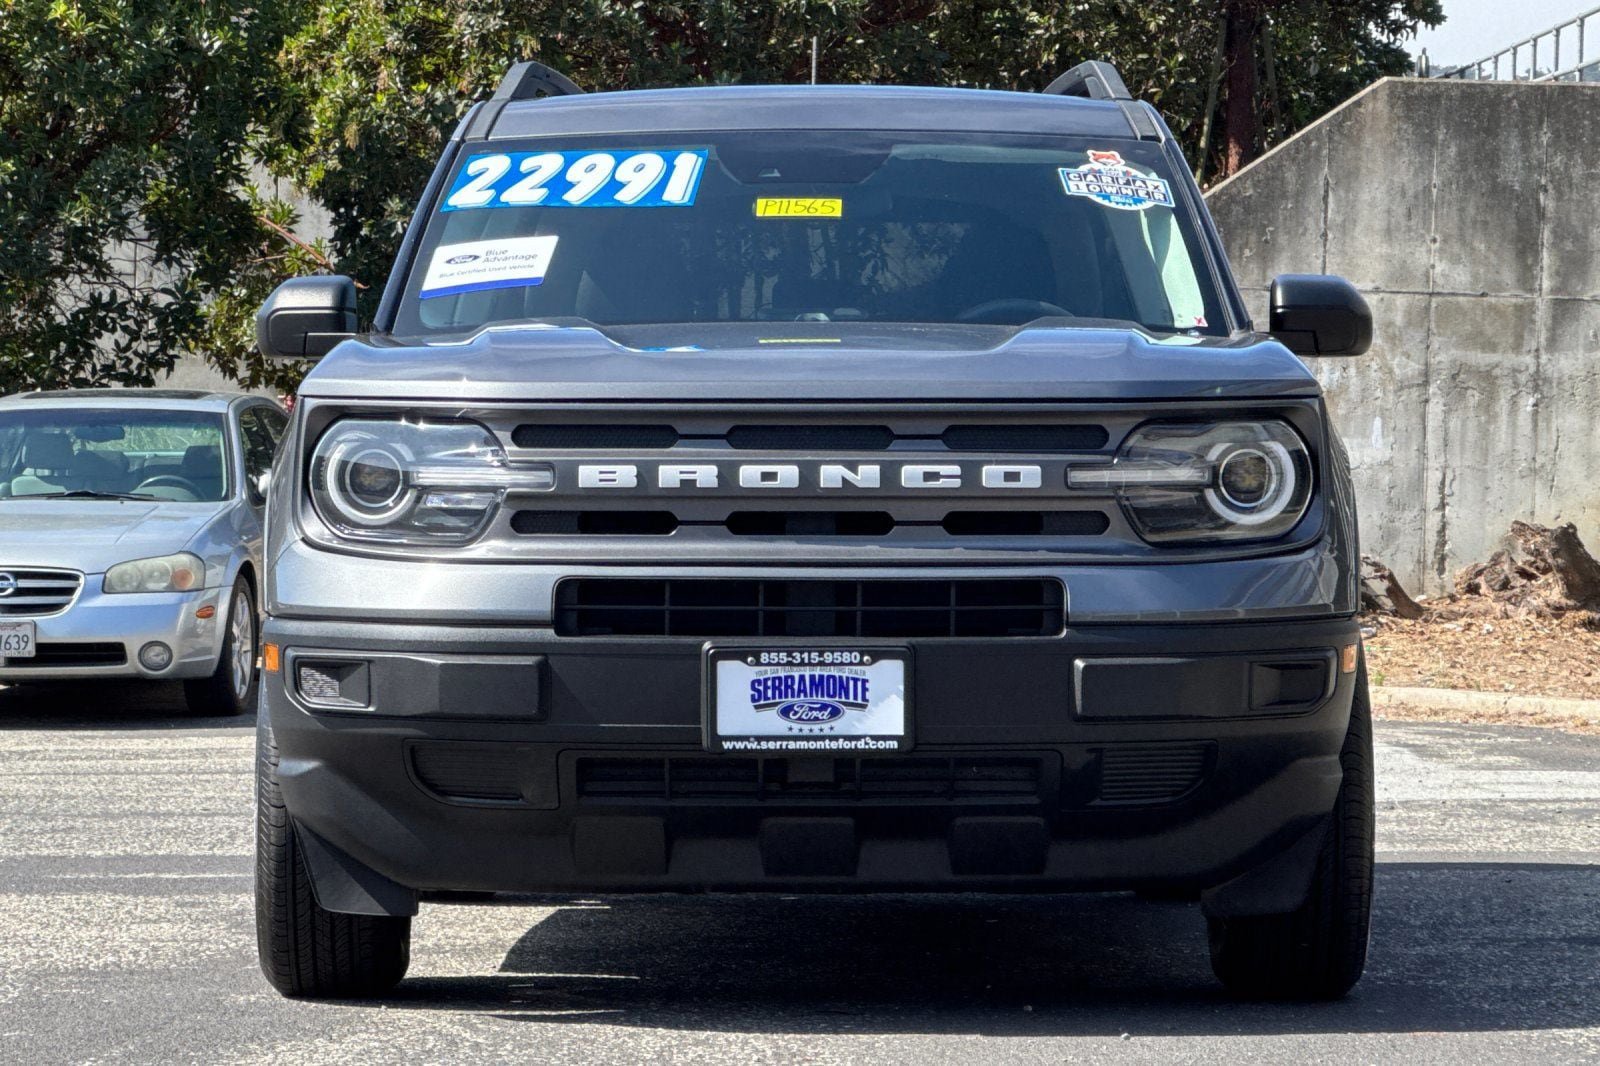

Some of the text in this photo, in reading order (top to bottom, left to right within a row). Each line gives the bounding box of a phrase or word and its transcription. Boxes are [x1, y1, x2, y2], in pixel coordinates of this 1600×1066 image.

[447, 152, 703, 206] 22991
[1068, 173, 1162, 191] CARFAX
[1087, 184, 1165, 201] OWNER
[483, 253, 538, 263] Advantage
[485, 248, 508, 257] Blue
[578, 465, 1042, 489] BRONCO
[760, 652, 861, 664] 855-315-9580
[847, 667, 866, 676] DEALER
[750, 673, 870, 704] SERRAMONTE
[789, 702, 831, 721] Ford
[722, 738, 899, 751] www.serramonteford.com
